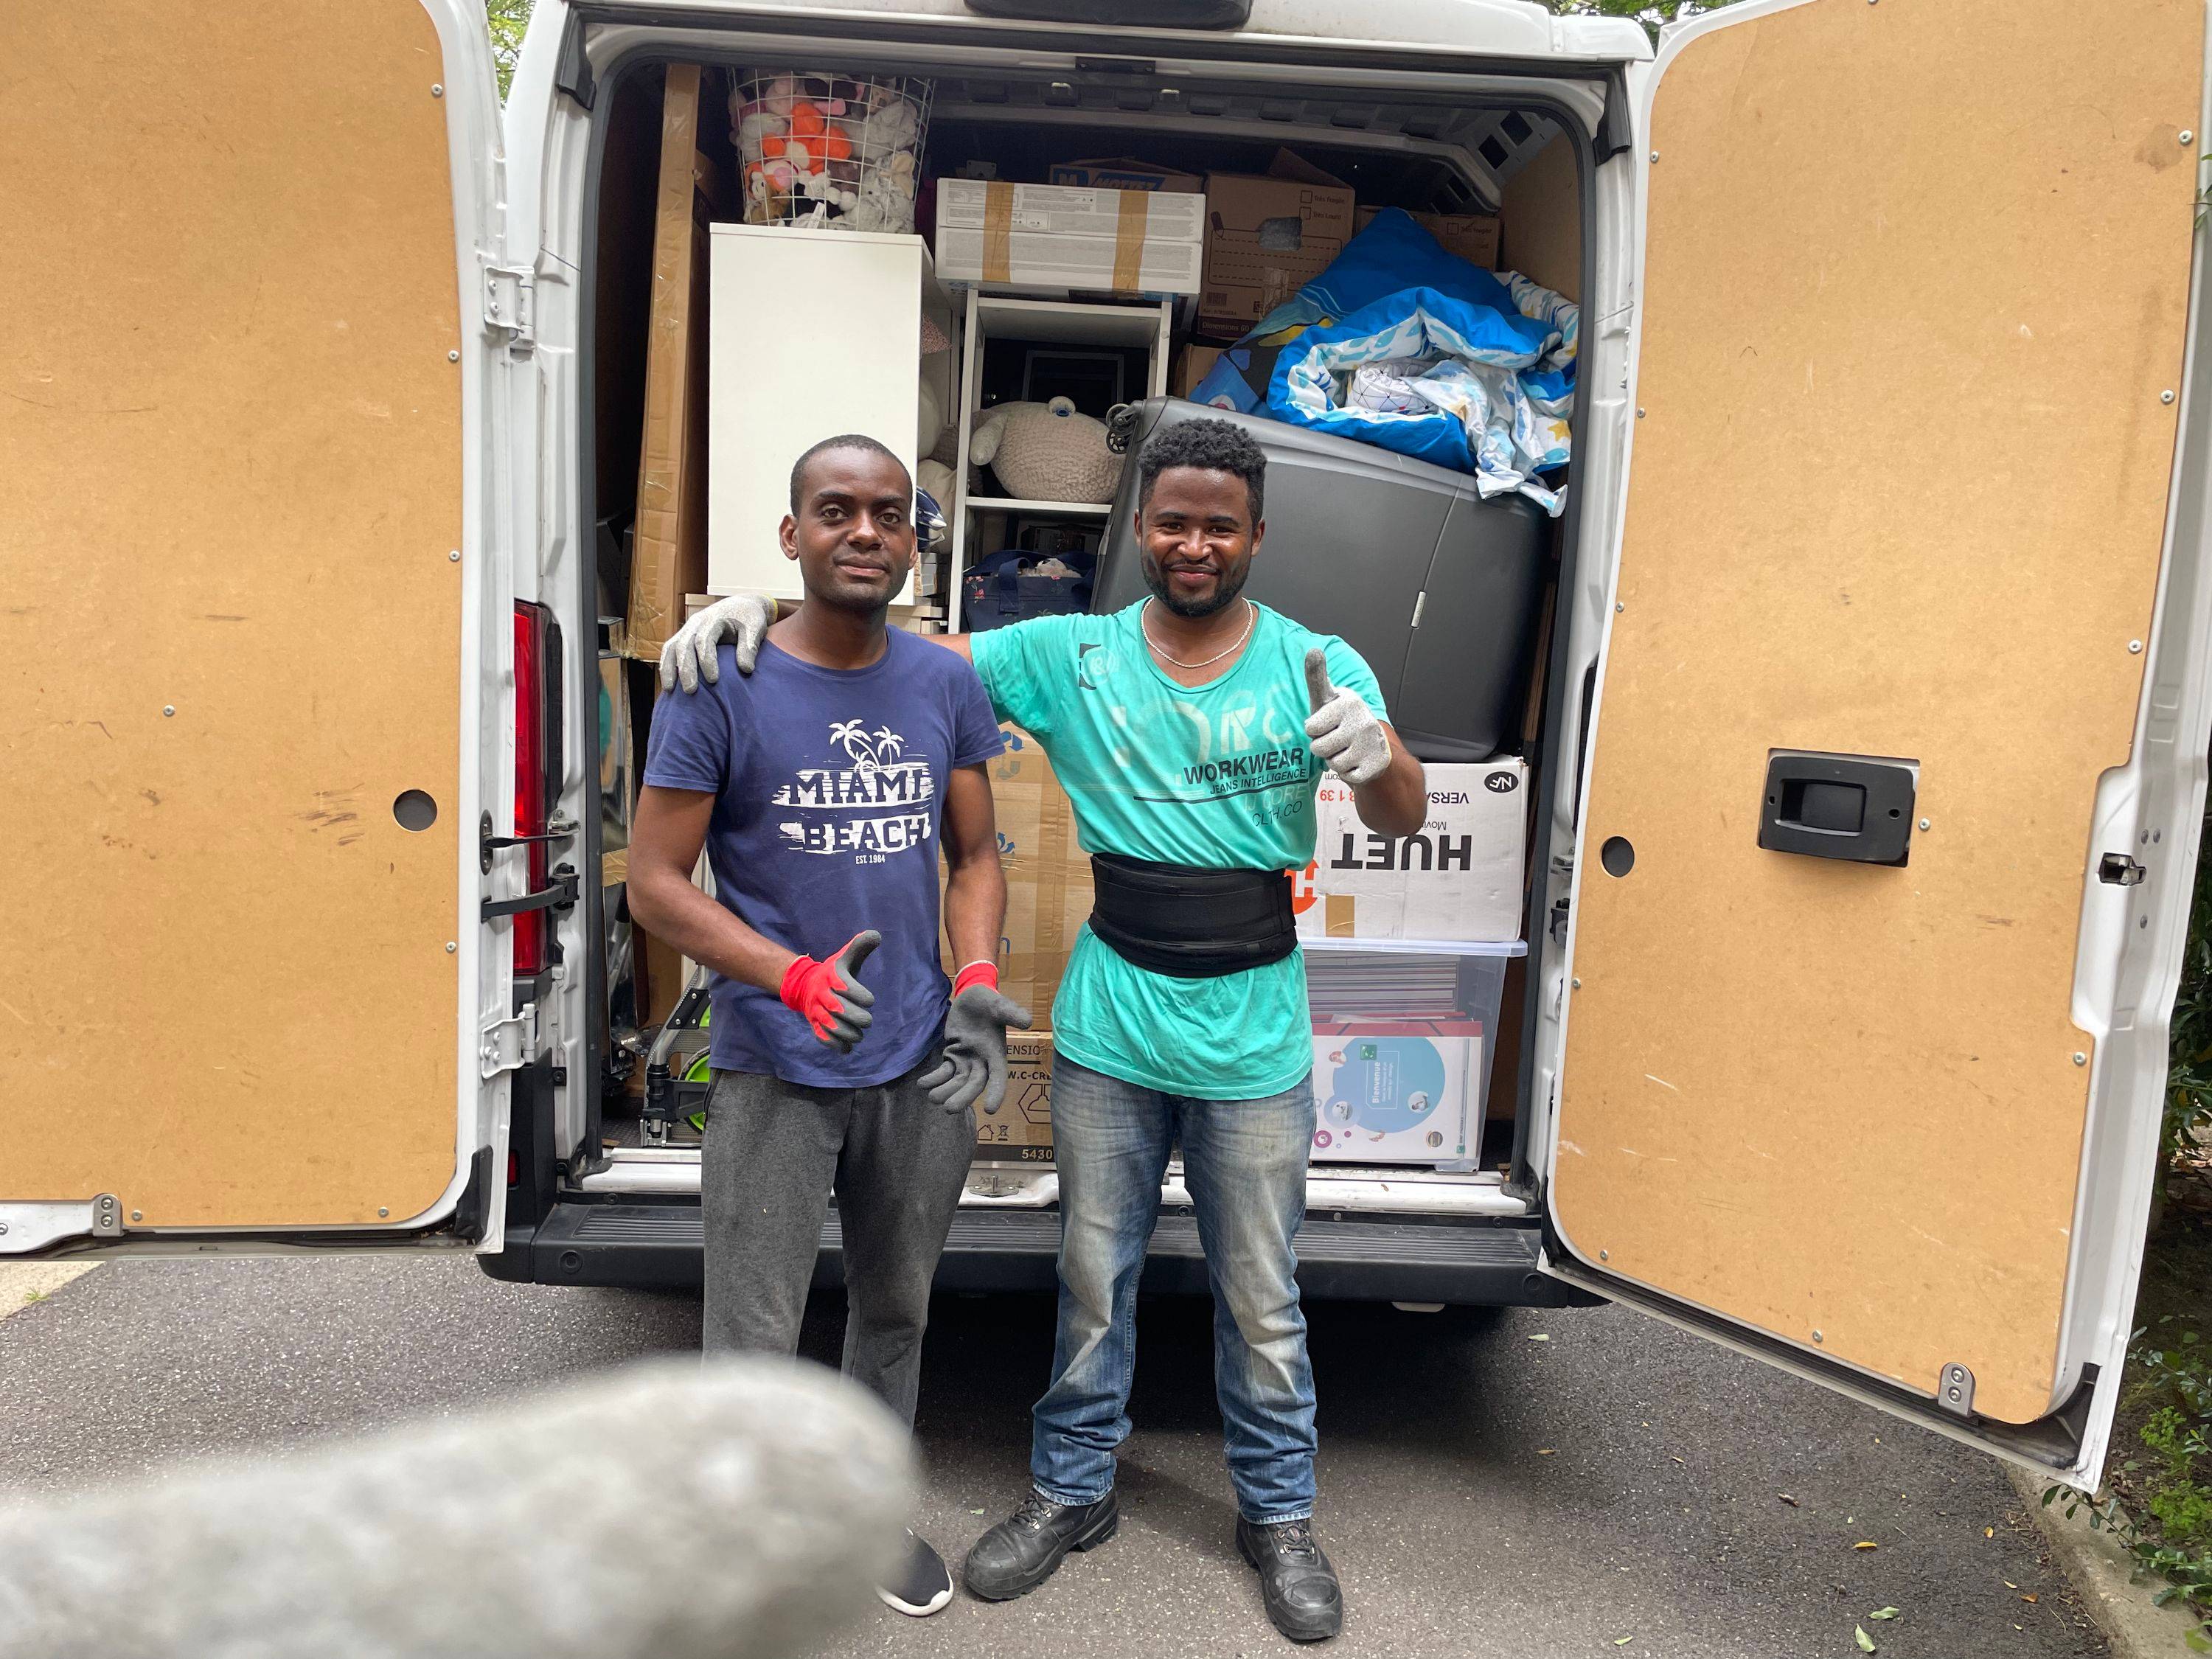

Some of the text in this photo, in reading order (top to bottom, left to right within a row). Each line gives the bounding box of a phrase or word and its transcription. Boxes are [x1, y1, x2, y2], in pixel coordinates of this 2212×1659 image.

[1184, 748, 1304, 785] WORKWEAR
[787, 769, 925, 805] MIAMI
[1210, 768, 1307, 795] JEANS INTELLIGENCE
[1489, 776, 1512, 788] NF
[1263, 784, 1309, 810] CORE
[1320, 790, 1335, 801] 39
[802, 817, 927, 850] BEACH
[869, 854, 886, 864] 1984
[1331, 833, 1472, 871] HUET
[1022, 1149, 1053, 1160] 5430
